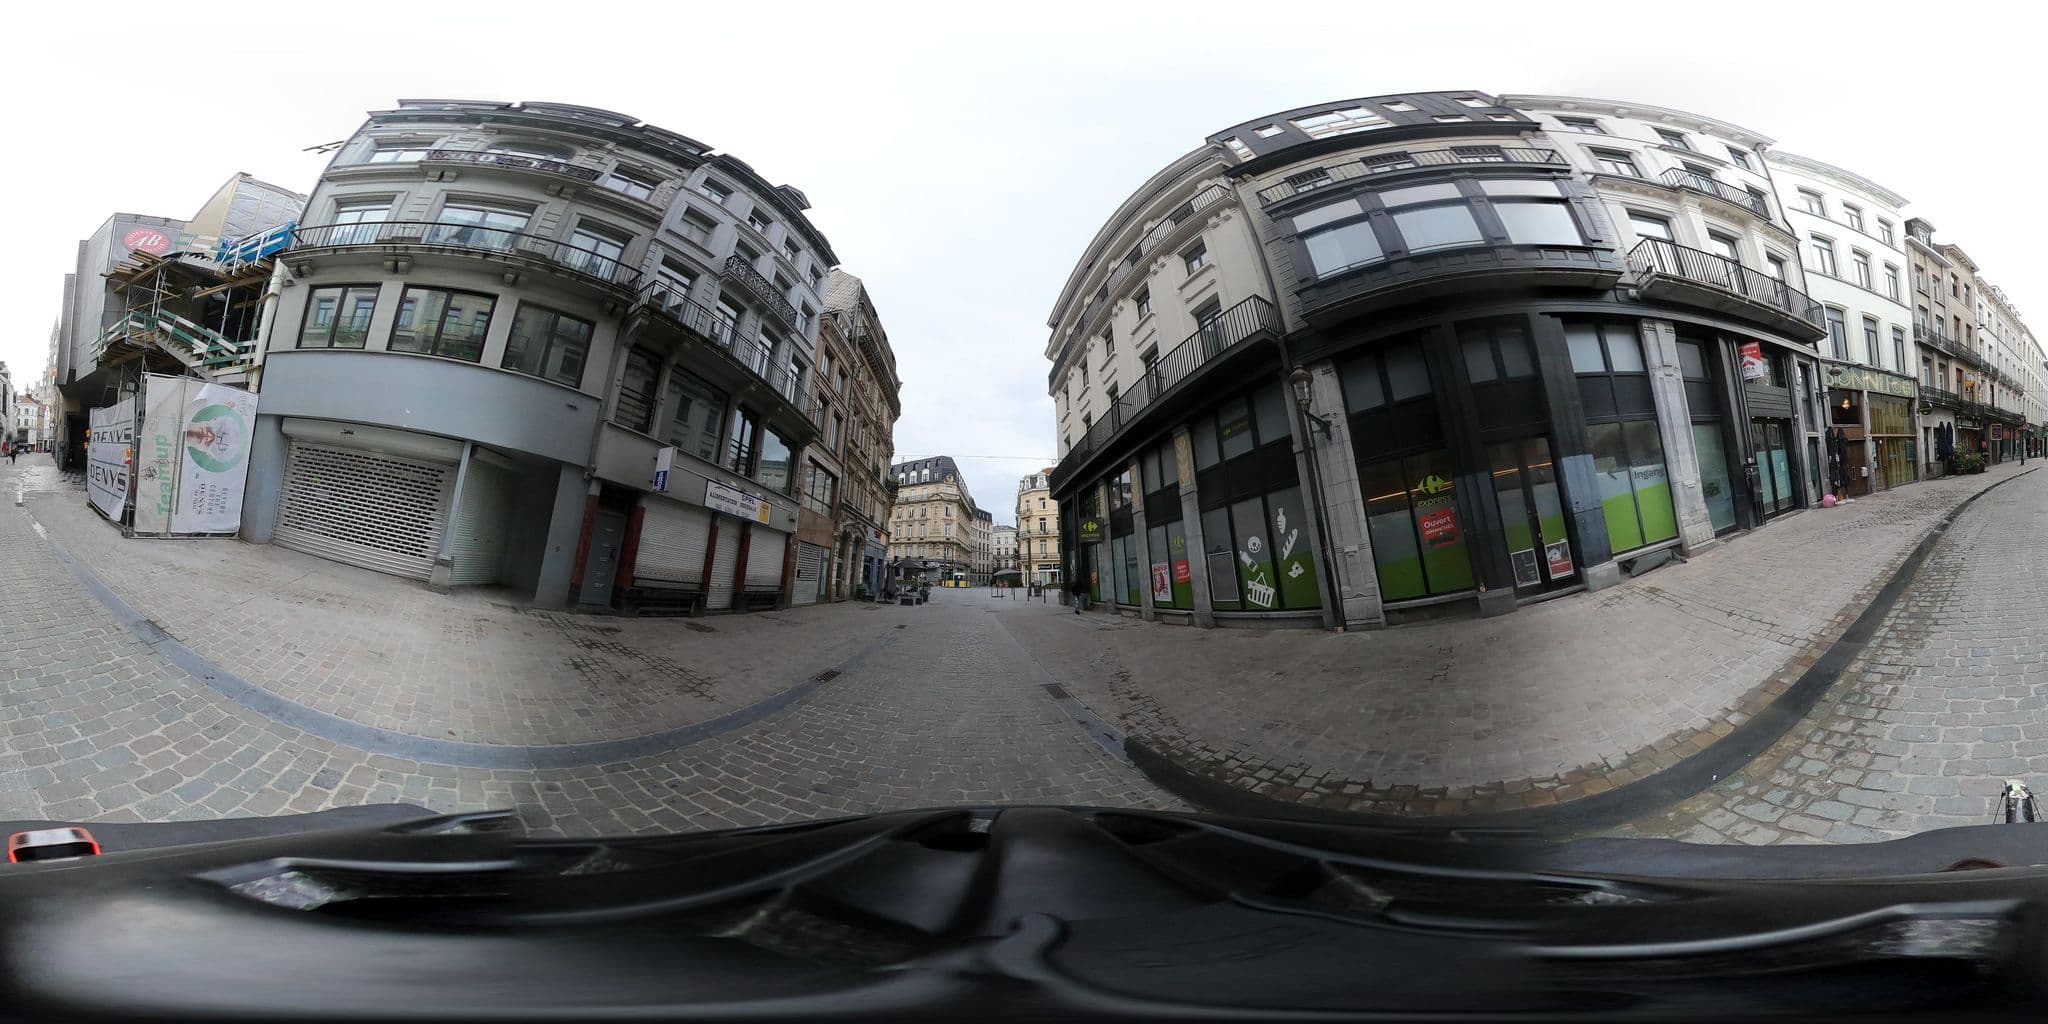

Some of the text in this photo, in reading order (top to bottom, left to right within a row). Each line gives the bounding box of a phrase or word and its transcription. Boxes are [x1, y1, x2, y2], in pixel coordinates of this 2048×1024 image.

[90, 463, 127, 492] DENYS
[1634, 468, 1665, 480] Ingang
[206, 484, 217, 515] CENTURY
[213, 494, 222, 508] THE
[219, 487, 229, 514] BEYOND
[1417, 494, 1455, 508] express
[1424, 516, 1452, 529] Ouvert
